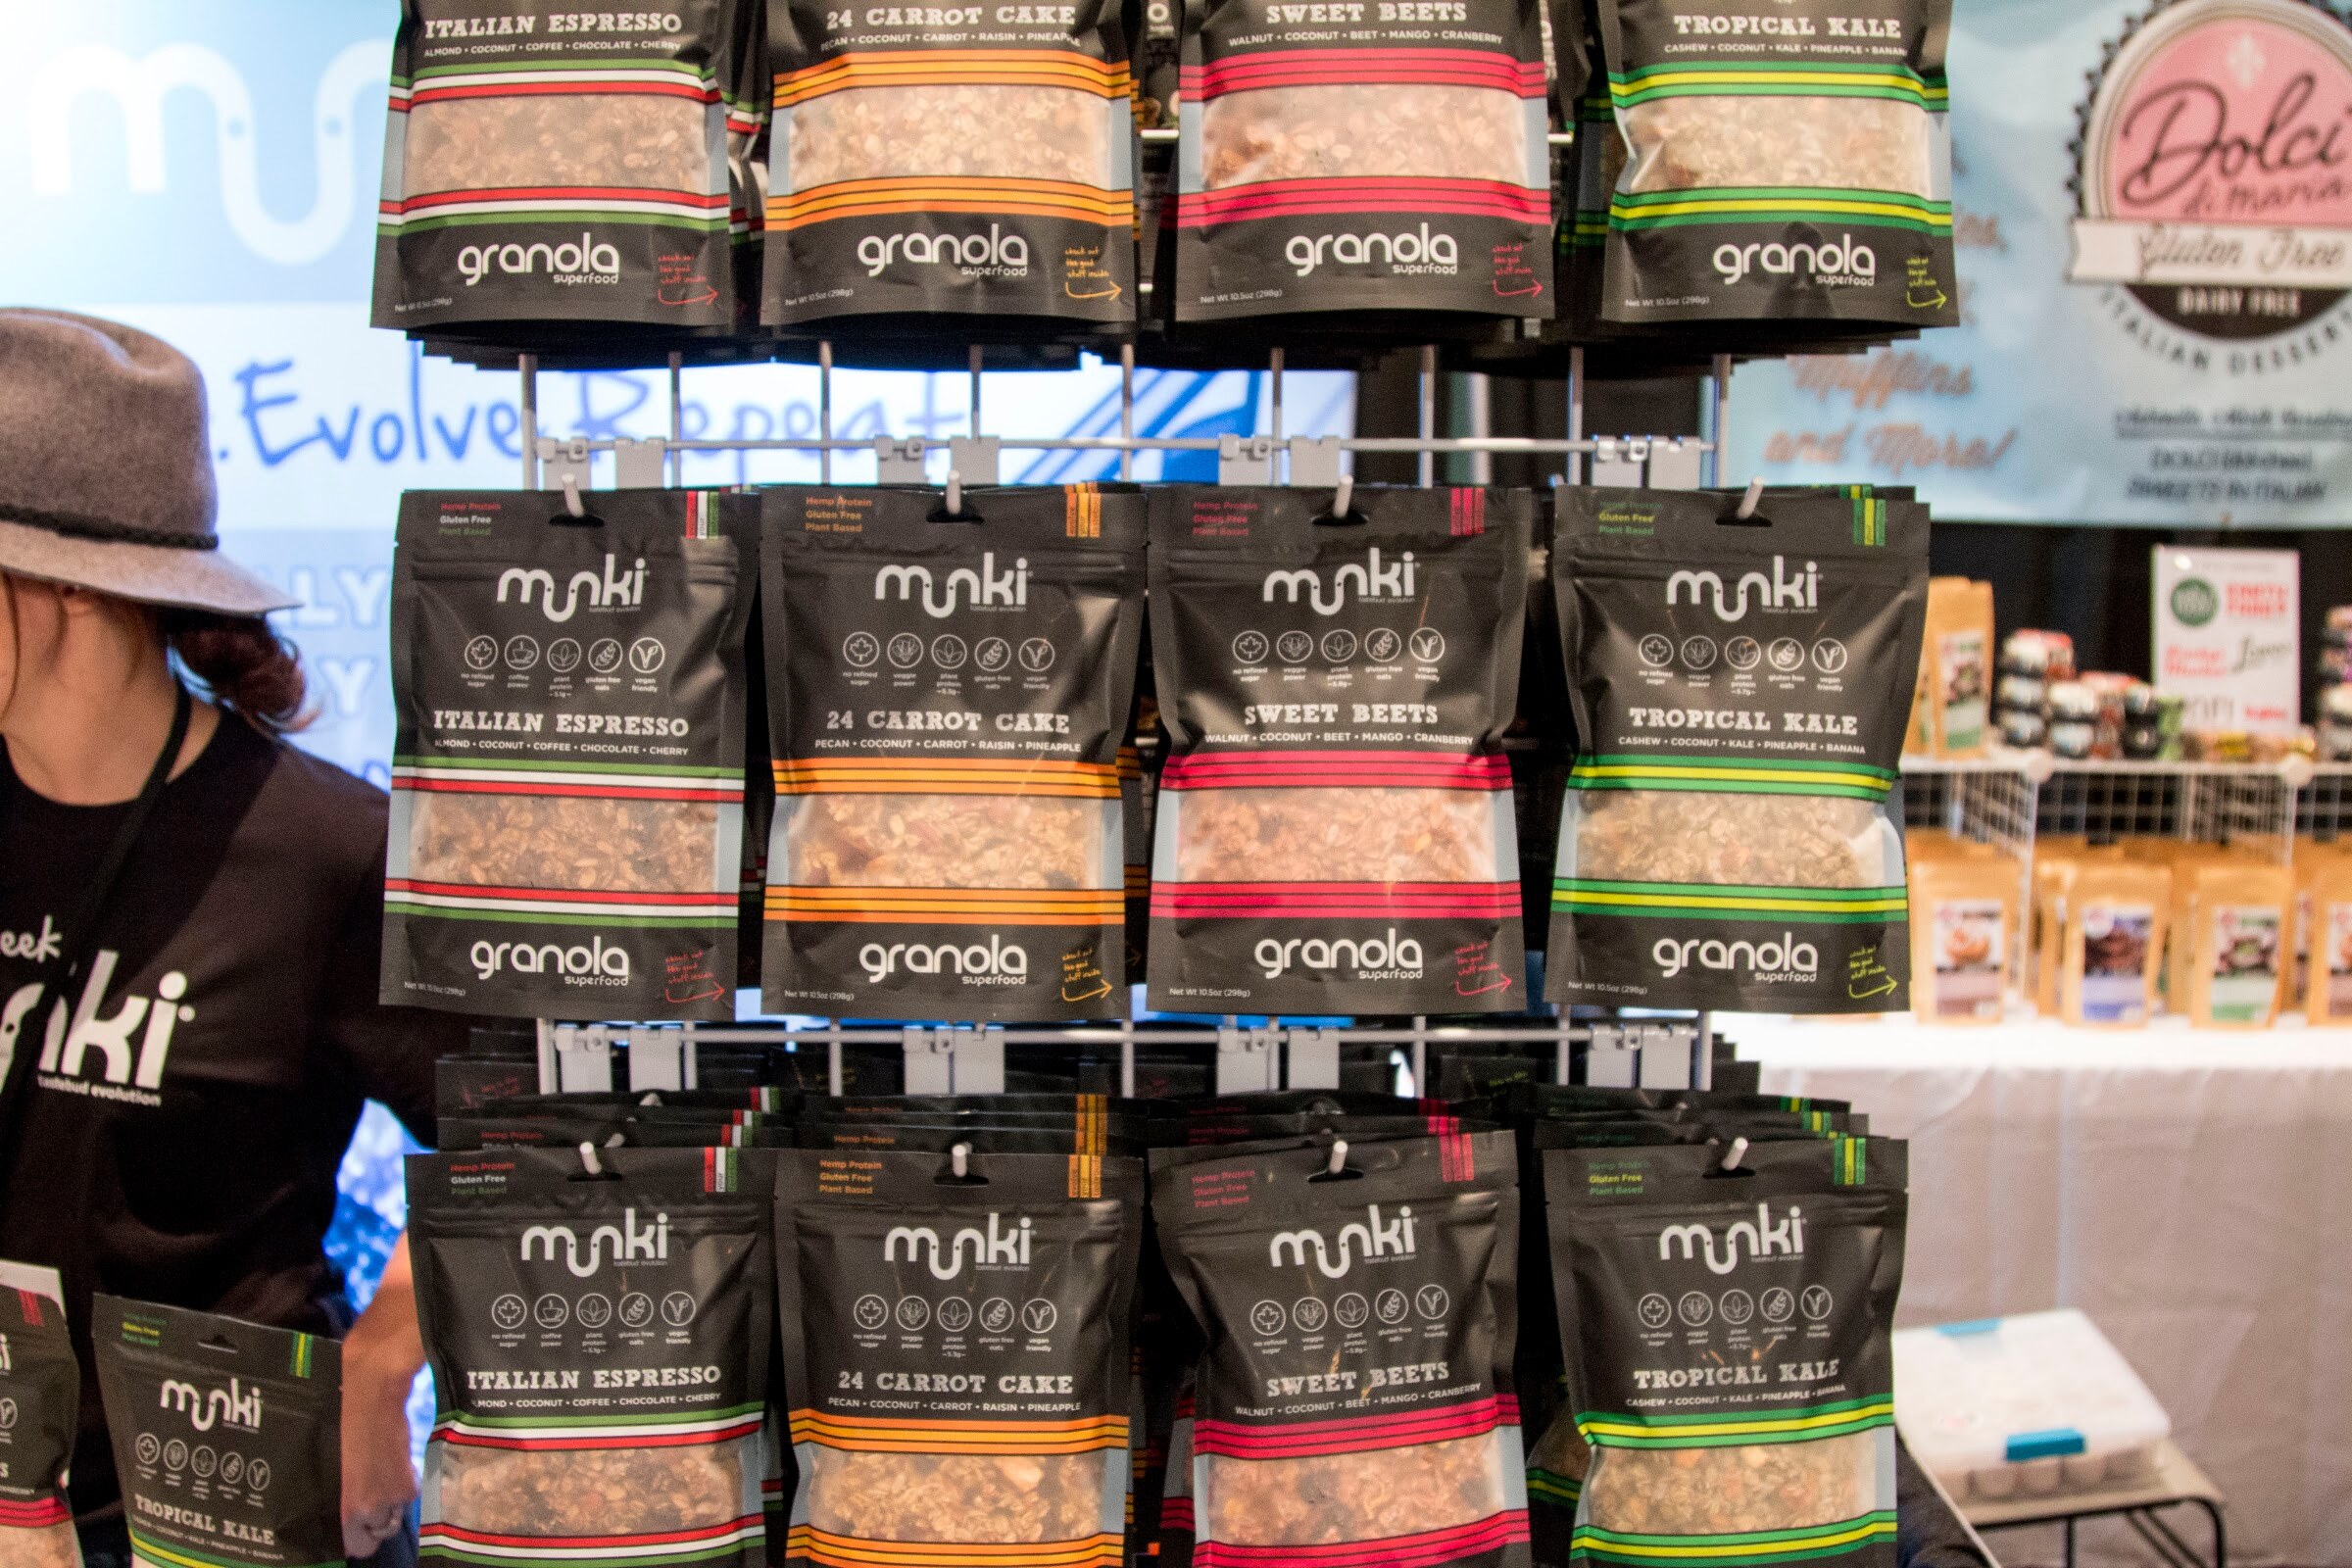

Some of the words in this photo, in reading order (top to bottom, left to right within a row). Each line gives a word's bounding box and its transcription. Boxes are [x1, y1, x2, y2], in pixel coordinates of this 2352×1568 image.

[826, 9, 853, 30] 24
[866, 8, 982, 25] CARROT
[997, 6, 1076, 24] CAKE
[1266, 4, 1364, 24] SWEET
[1380, 3, 1467, 22] BEETS
[424, 16, 536, 38] ITALIAN
[549, 13, 682, 32] ESPRESSO
[1674, 16, 1815, 36] TROPICAL
[1828, 18, 1901, 38] KALE
[424, 46, 463, 57] ALMOND
[471, 44, 516, 54] COCONUT
[525, 42, 564, 51] COFFEE
[572, 41, 630, 50] CHOCOLATE
[641, 40, 682, 51] CHERRY
[821, 38, 848, 51] PECAN
[858, 34, 911, 43] COCONUT
[923, 33, 967, 42] CARROT
[979, 32, 1016, 41] RAISIN
[1229, 33, 1273, 47] WALNUT
[1285, 31, 1338, 41] COCONUT
[1350, 30, 1378, 39] BEET
[1390, 30, 1430, 40] MANGO
[1443, 30, 1502, 44] CRANBERRY
[1665, 44, 1707, 53] CASHEW
[1718, 43, 1765, 52] COCONUT
[1776, 44, 1801, 53] KALE
[1811, 45, 1862, 55] PINEAPPLE
[2119, 71, 2352, 207] Dolci
[458, 232, 619, 286] granola
[858, 223, 1028, 277] granola
[1286, 222, 1457, 276] granola
[1713, 233, 1876, 285] granola
[2138, 220, 2244, 279] Gluten
[2257, 227, 2345, 273] Free
[553, 272, 618, 285] superfood
[961, 265, 1027, 277] superfood
[1393, 264, 1457, 274] superfood
[1816, 273, 1875, 287] superfood
[234, 341, 521, 466] Evolve
[806, 498, 834, 507] Hemp
[837, 497, 872, 507] Protein
[440, 515, 466, 524] Gluten
[468, 515, 491, 524] Free
[806, 511, 835, 519] Gluten
[1599, 513, 1629, 521] Gluten
[1632, 514, 1654, 522] Free
[805, 523, 829, 532] Plant
[833, 523, 862, 532] Based
[497, 553, 646, 622] munki
[875, 552, 1027, 618] munki
[1263, 548, 1415, 615] munki
[1667, 556, 1817, 622] munki
[433, 710, 543, 732] ITALIAN
[557, 713, 688, 736] ESPRESSO
[826, 710, 854, 729] 24
[867, 710, 981, 731] CARROT
[996, 713, 1069, 733] CAKE
[1245, 704, 1339, 725] SWEET
[1352, 704, 1438, 723] BEETS
[1629, 708, 1770, 731] TROPICAL
[1784, 712, 1857, 735] KALE
[434, 739, 469, 749] ALMOND
[478, 740, 523, 750] COCONUT
[534, 742, 570, 752] COFFEE
[580, 743, 639, 754] CHOCOLATE
[649, 746, 688, 756] CHERRY
[815, 740, 850, 749] PECAN
[860, 740, 912, 749] COCONUT
[924, 740, 967, 749] CARROT
[979, 741, 1014, 750] RAISIN
[1026, 742, 1080, 752] PINEAPPLE
[1205, 734, 1250, 743] WALNUT
[1260, 733, 1312, 742] COCONUT
[1324, 732, 1350, 741] BEET
[1363, 733, 1403, 742] MANGO
[1414, 734, 1473, 745] CRANBERRY
[1619, 737, 1661, 746] CASHEW
[1671, 738, 1719, 747] COCONUT
[1729, 739, 1754, 748] KALE
[1764, 740, 1817, 751] PINEAPPLE
[1827, 743, 1865, 754] BANANA
[471, 936, 629, 980] granola
[859, 934, 1027, 983] granola
[1255, 928, 1422, 979] granola
[1653, 932, 1818, 978] granola
[564, 975, 628, 987] superfood
[962, 974, 1027, 986] superfood
[1358, 969, 1423, 981] superfood
[1755, 972, 1817, 983] superfood
[1199, 988, 1222, 997] 10.5oz
[1224, 988, 1250, 998] (298g)
[1585, 982, 1595, 991] Wt
[1597, 983, 1619, 992] 10.5oz
[1621, 985, 1647, 994] (298g)
[90, 1083, 161, 1107] evolution
[820, 1159, 845, 1169] Hemp
[849, 1160, 881, 1169] Protein
[451, 1175, 481, 1184] Gluten
[819, 1173, 849, 1182] Gluten
[1590, 1174, 1619, 1184] Gluten
[819, 1185, 842, 1194] Plant
[845, 1185, 873, 1195] Based
[521, 1207, 667, 1277] munki
[884, 1213, 1031, 1280] munki
[1270, 1204, 1416, 1279] munki
[1660, 1203, 1803, 1275] munki
[467, 1371, 579, 1390] ITALIAN
[593, 1366, 721, 1389] ESPRESSO
[839, 1372, 863, 1390] 24
[877, 1373, 985, 1393] CARROT
[999, 1376, 1073, 1394] CAKE
[1267, 1372, 1356, 1396] SWEET
[1370, 1362, 1448, 1388] BEETS
[1634, 1366, 1767, 1389] TROPICAL
[1779, 1359, 1840, 1382] KALE
[161, 1378, 261, 1432] munki
[572, 1397, 610, 1406] COFFEE
[619, 1396, 676, 1405] CHOCOLATE
[686, 1393, 720, 1402] CHERRY
[828, 1397, 859, 1407] PECAN
[870, 1400, 920, 1409] COCONUT
[931, 1401, 972, 1410] CARROT
[983, 1402, 1017, 1412] RAISIN
[1028, 1402, 1080, 1412] PINEAPPLE
[1235, 1405, 1273, 1417] WALNUT
[1286, 1402, 1335, 1414] COCONUT
[1346, 1398, 1370, 1409] BEET
[1381, 1394, 1418, 1405] MANGO
[1429, 1383, 1481, 1399] CRANBERRY
[1627, 1397, 1666, 1406] CASHEW
[1675, 1396, 1720, 1405] COCONUT
[1730, 1394, 1752, 1403] KALE
[1762, 1391, 1810, 1401] PINEAPPLE
[135, 1494, 216, 1532] TROPICAL
[222, 1520, 274, 1545] KALE
